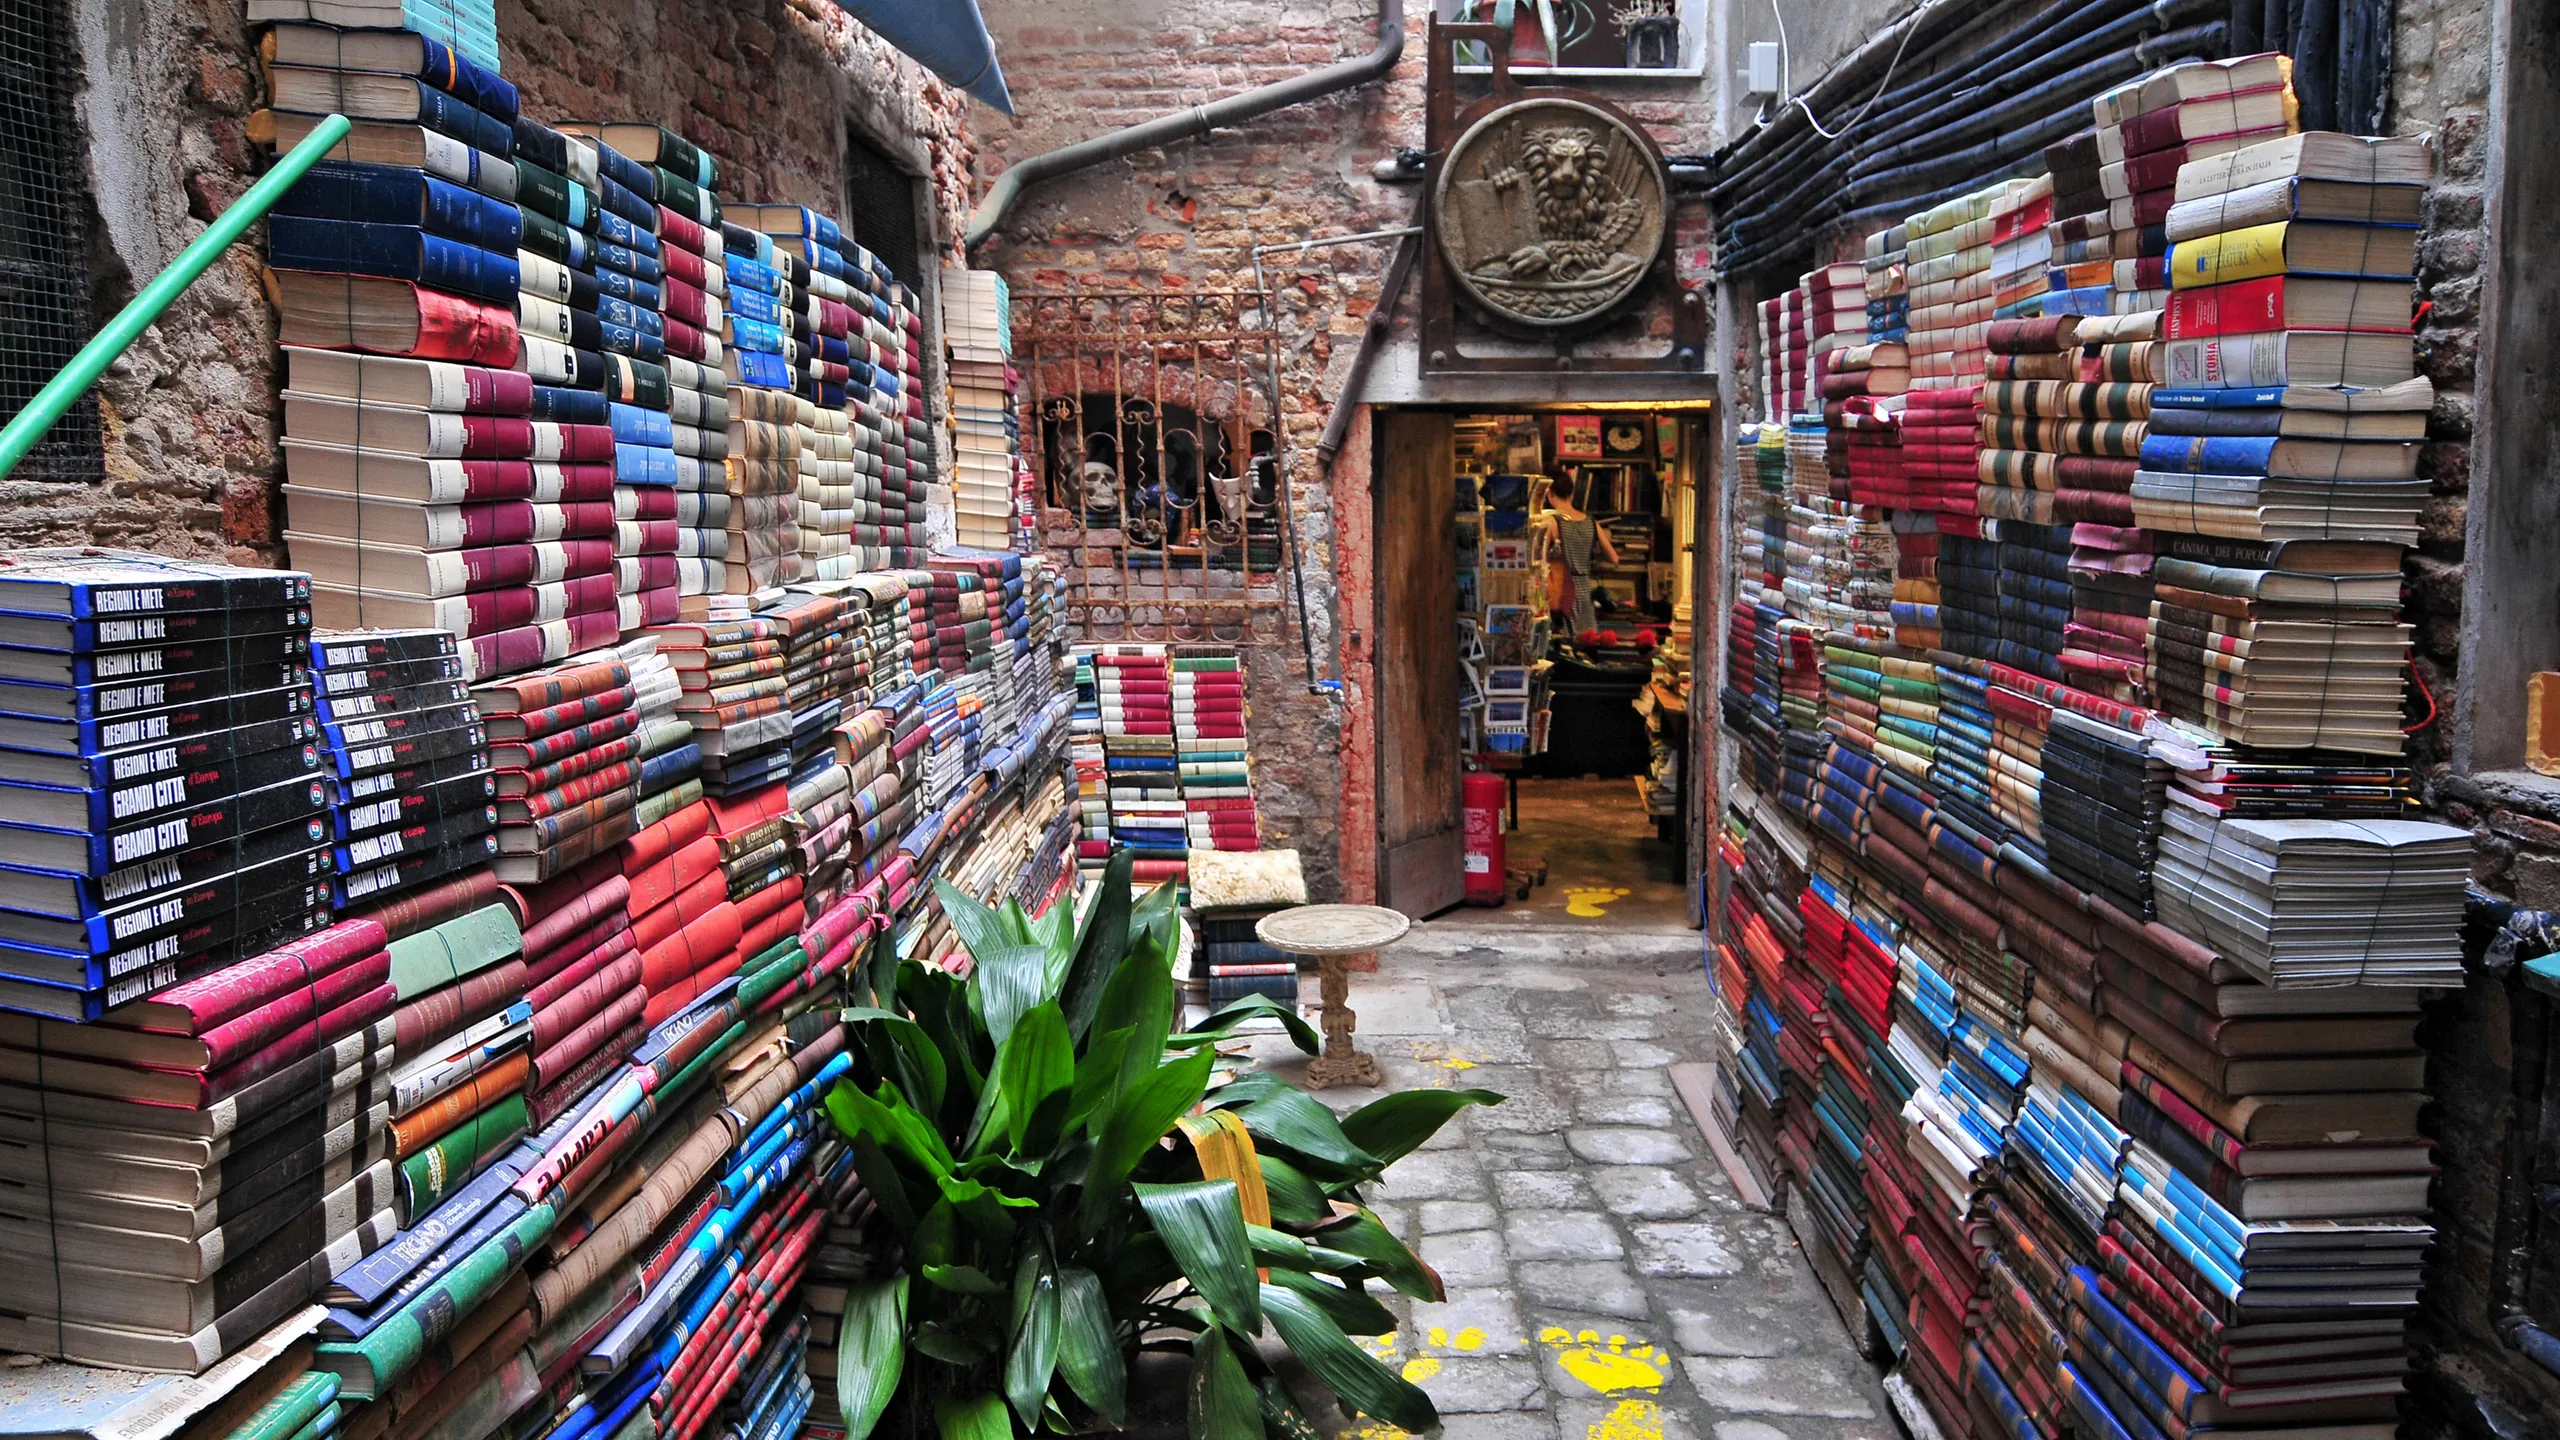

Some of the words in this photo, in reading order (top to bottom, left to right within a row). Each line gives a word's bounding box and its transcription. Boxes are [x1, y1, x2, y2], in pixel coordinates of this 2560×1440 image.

[2207, 342, 2217, 382] STORIA
[2172, 541, 2210, 556] L'ANIMA
[2215, 546, 2230, 557] DEI
[2235, 548, 2272, 562] POPOLI
[96, 591, 131, 613] REGIONI
[132, 590, 140, 610] E
[141, 588, 164, 609] METE
[100, 621, 135, 643] REGIONI
[137, 621, 144, 640] E
[144, 619, 165, 639] METE
[97, 654, 132, 677] REGIONI
[134, 653, 141, 672] E
[141, 650, 163, 672] METE
[100, 689, 135, 712] REGIONI
[137, 687, 142, 707] E
[143, 683, 165, 705] METE
[103, 723, 140, 746] REGIONI
[141, 721, 146, 739] E
[147, 715, 169, 739] METE
[113, 754, 149, 780] REGIONI
[150, 753, 156, 771] E
[156, 747, 178, 771] METE
[112, 784, 153, 819] GRANDI
[350, 804, 379, 831] GRANDI
[113, 827, 154, 863] GRANDI
[350, 837, 382, 864] GRANDI
[113, 911, 152, 940] REGIONI
[153, 910, 159, 930] E
[159, 898, 184, 925] METE
[110, 948, 148, 977] REGIONI
[149, 948, 156, 967] E
[156, 935, 179, 961] METE
[391, 1218, 448, 1265] TECHNO
[117, 1396, 186, 1440] ENCICLOPEDIA
[186, 1382, 206, 1398] DEI
